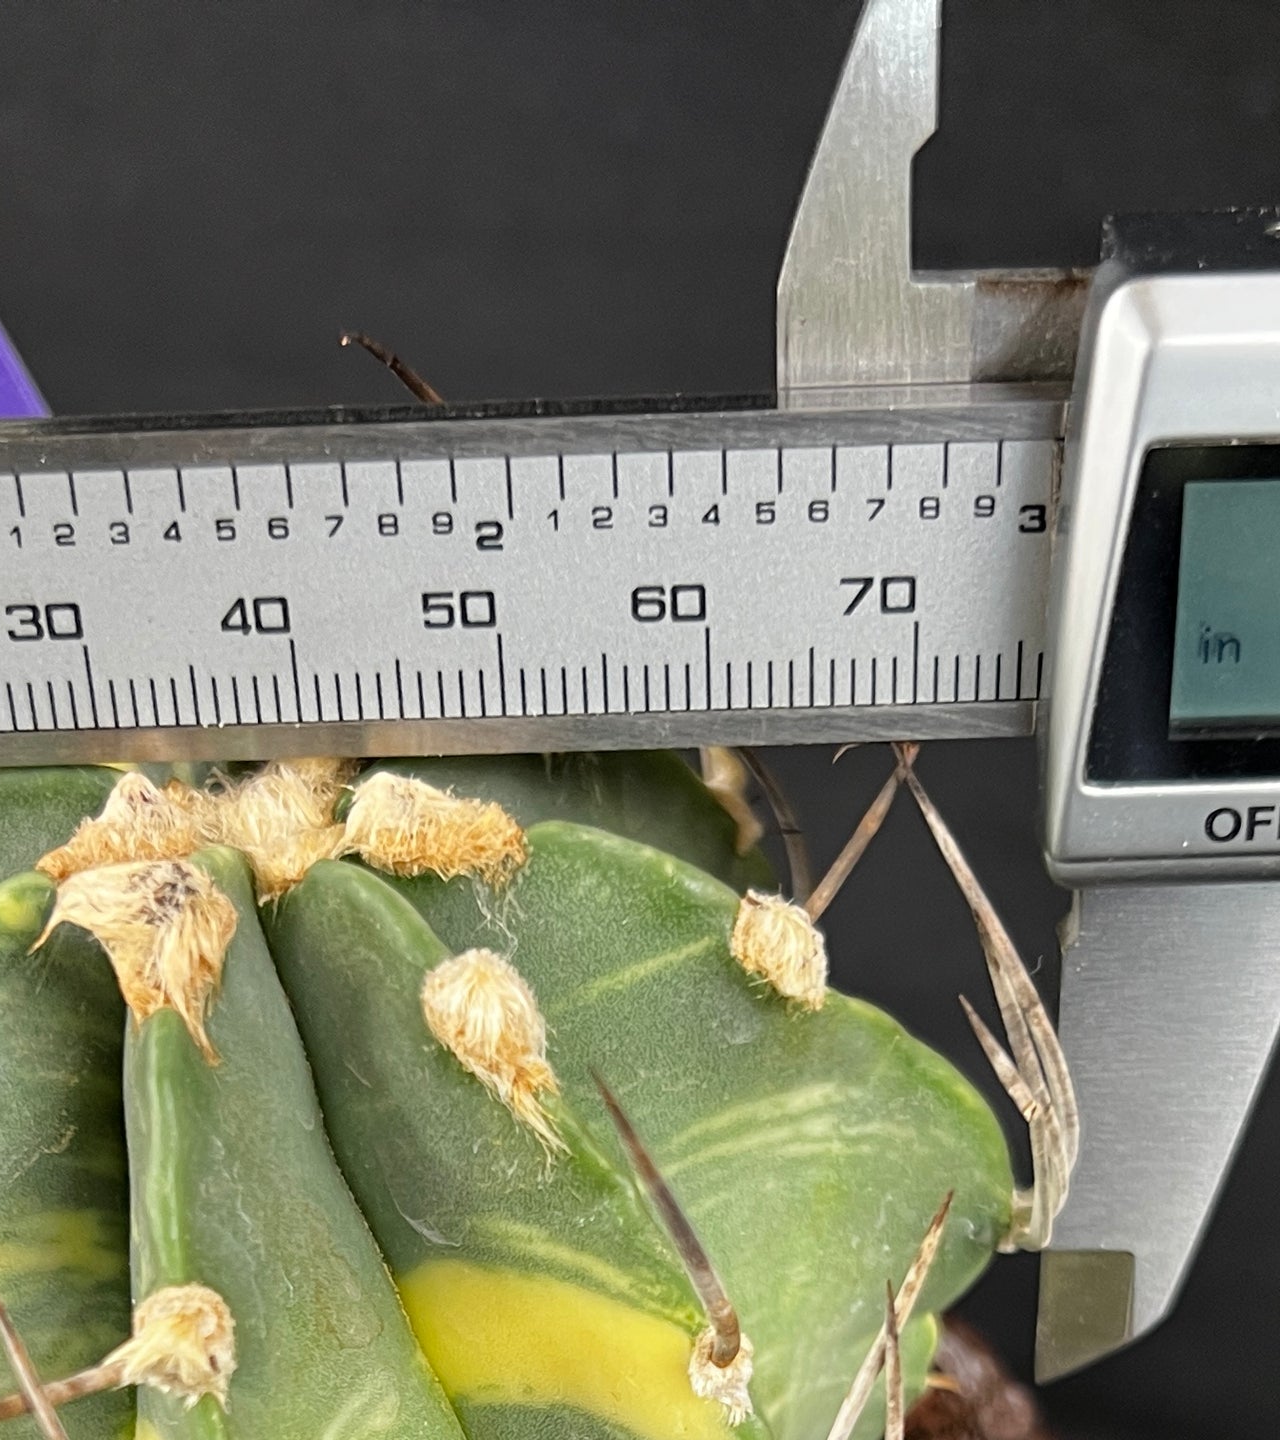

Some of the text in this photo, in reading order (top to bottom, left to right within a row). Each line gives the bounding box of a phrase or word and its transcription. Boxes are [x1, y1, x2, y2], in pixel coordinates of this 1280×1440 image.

[9, 525, 23, 549] 1
[52, 522, 77, 547] 2
[108, 520, 131, 545] 3
[162, 520, 183, 543] 4
[214, 518, 237, 542] 5
[267, 516, 290, 540] 6
[324, 514, 345, 538] 7
[377, 512, 400, 537] 8
[431, 511, 454, 536] 9
[474, 519, 504, 552] 2
[546, 508, 559, 532] 1
[591, 505, 614, 530] 2
[648, 503, 669, 528] 3
[701, 502, 721, 527] 4
[755, 500, 776, 525] 5
[807, 499, 830, 524] 6
[866, 497, 886, 522] 7
[918, 495, 941, 520] 8
[973, 494, 996, 518] 9
[1018, 503, 1047, 534] 3
[4, 602, 85, 643] 30
[220, 595, 292, 636] 40
[420, 589, 497, 630] 50
[630, 583, 707, 623] 60
[839, 575, 917, 617] 70
[1199, 626, 1241, 664] in
